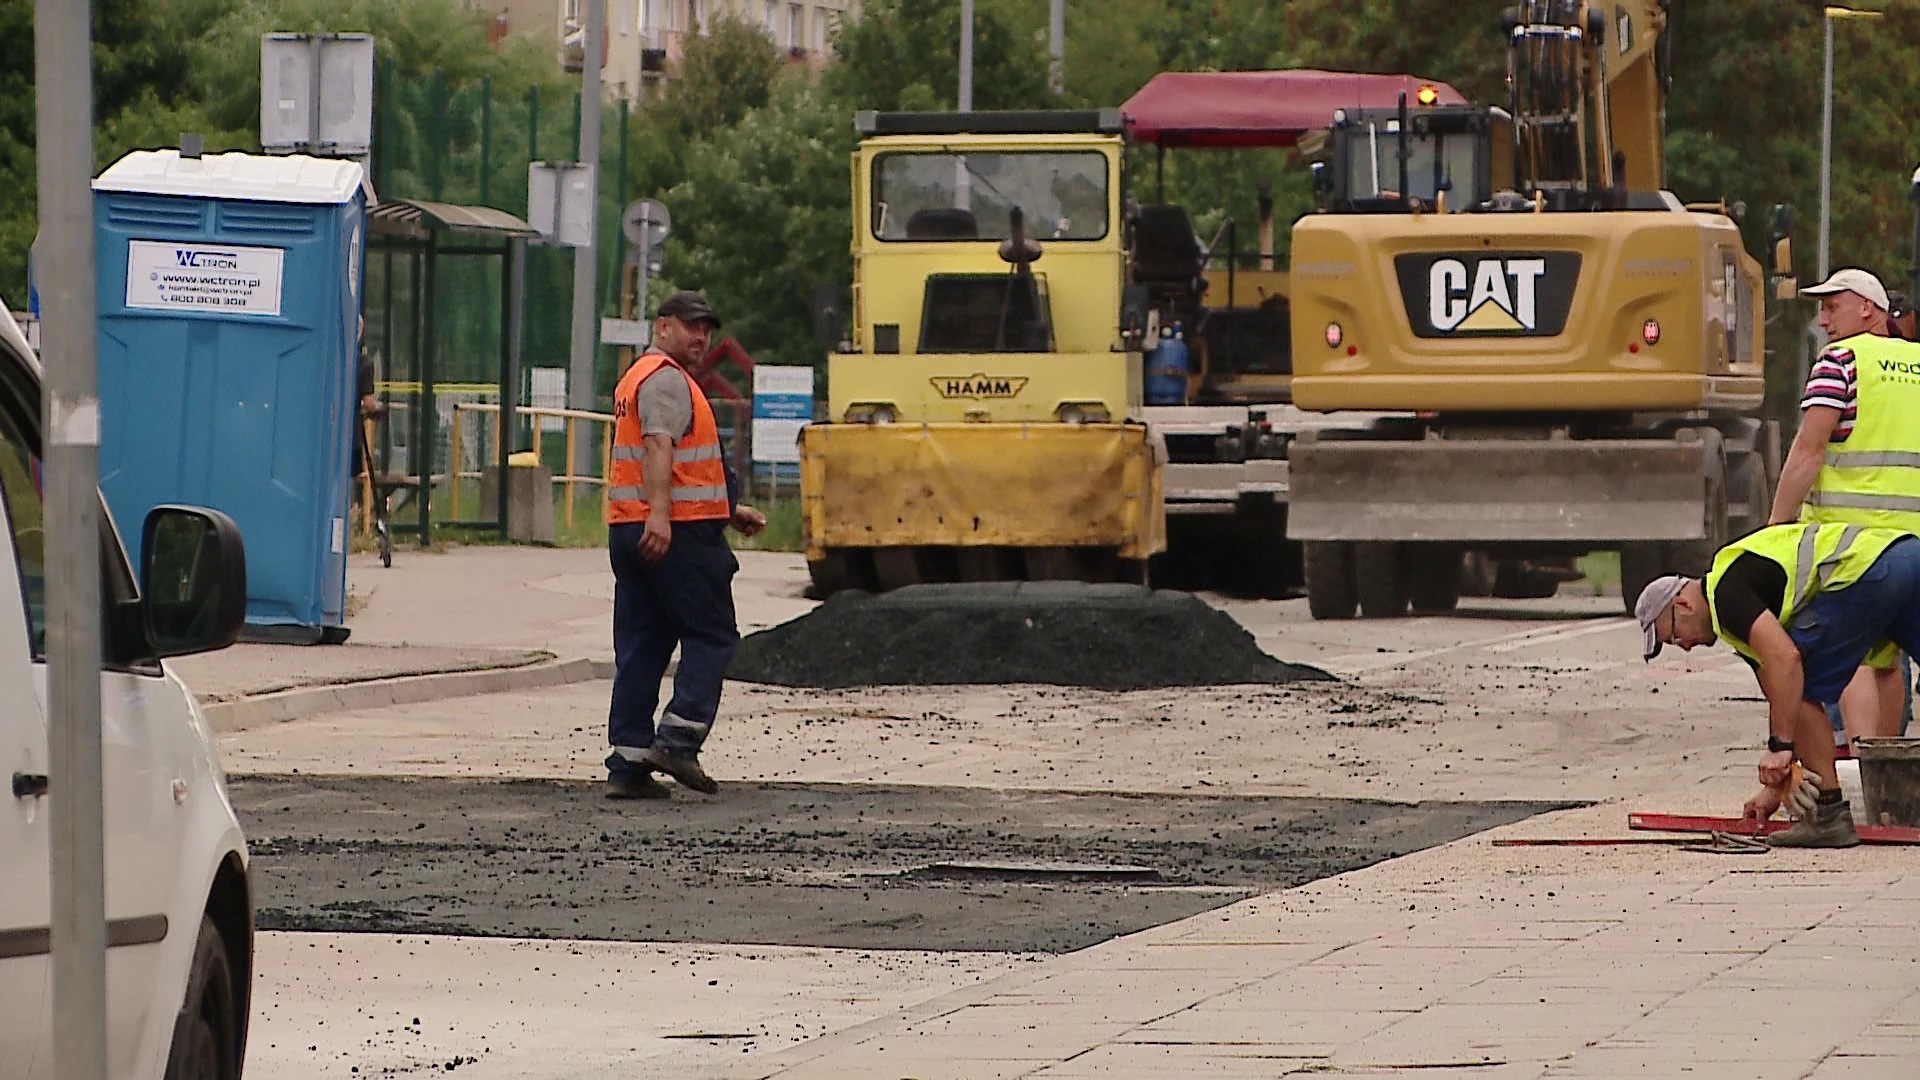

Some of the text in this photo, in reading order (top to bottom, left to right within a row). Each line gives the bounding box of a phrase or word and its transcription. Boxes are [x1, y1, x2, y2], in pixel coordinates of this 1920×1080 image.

[163, 274, 260, 288] www.wctron.pl
[1430, 259, 1545, 330] CAT
[947, 381, 1011, 394] HAMM
